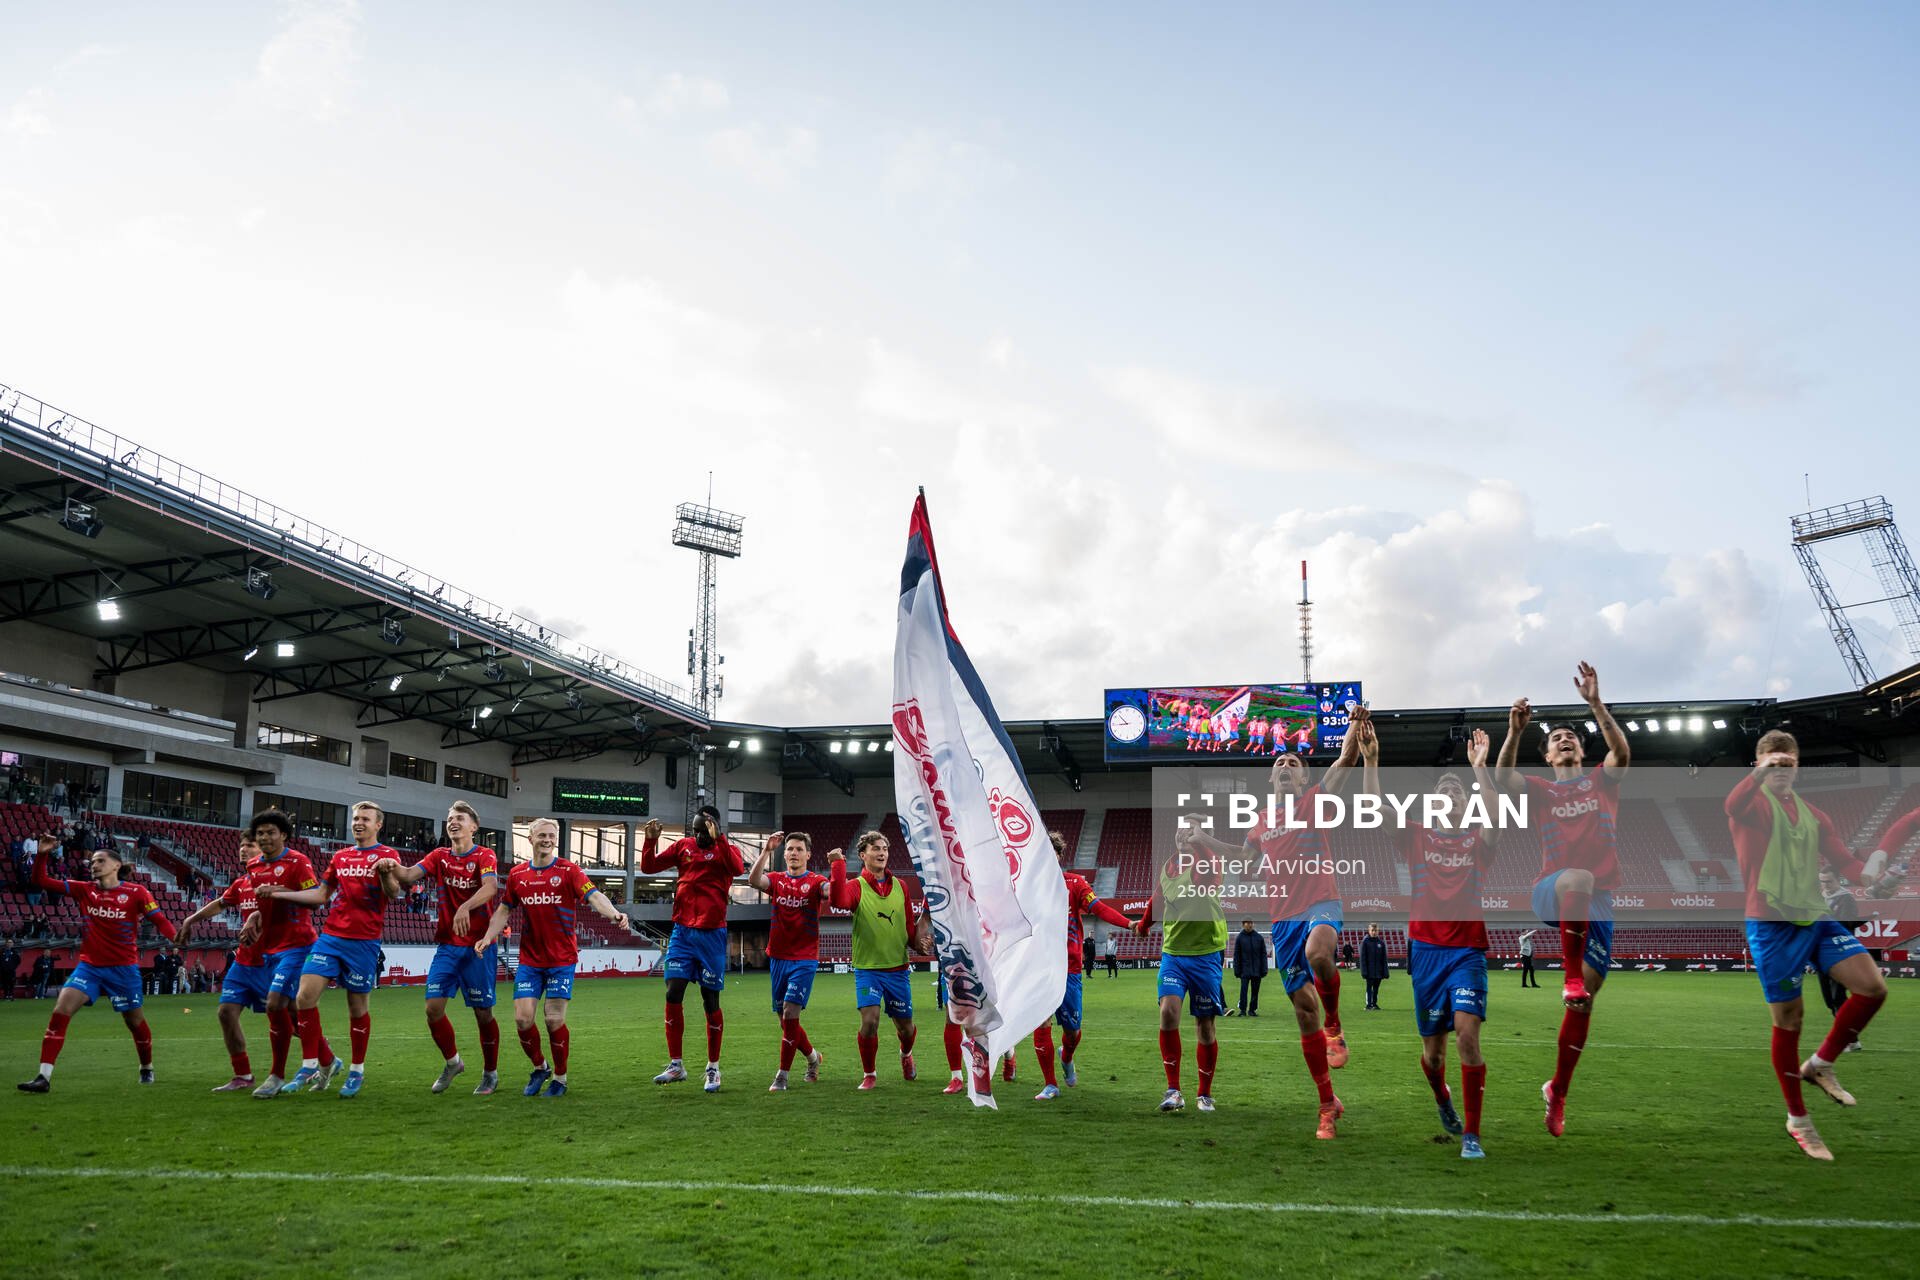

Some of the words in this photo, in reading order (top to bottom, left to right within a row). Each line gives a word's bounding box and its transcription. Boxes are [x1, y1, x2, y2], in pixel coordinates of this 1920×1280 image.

[1322, 687, 1330, 697] 5
[1347, 687, 1354, 696] 1
[1322, 716, 1352, 726] 93:0
[521, 892, 562, 905] vobbiz
[1351, 898, 1392, 909] RAMLÖSA
[1671, 894, 1715, 907] vobbiz
[87, 905, 127, 919] vobbiz
